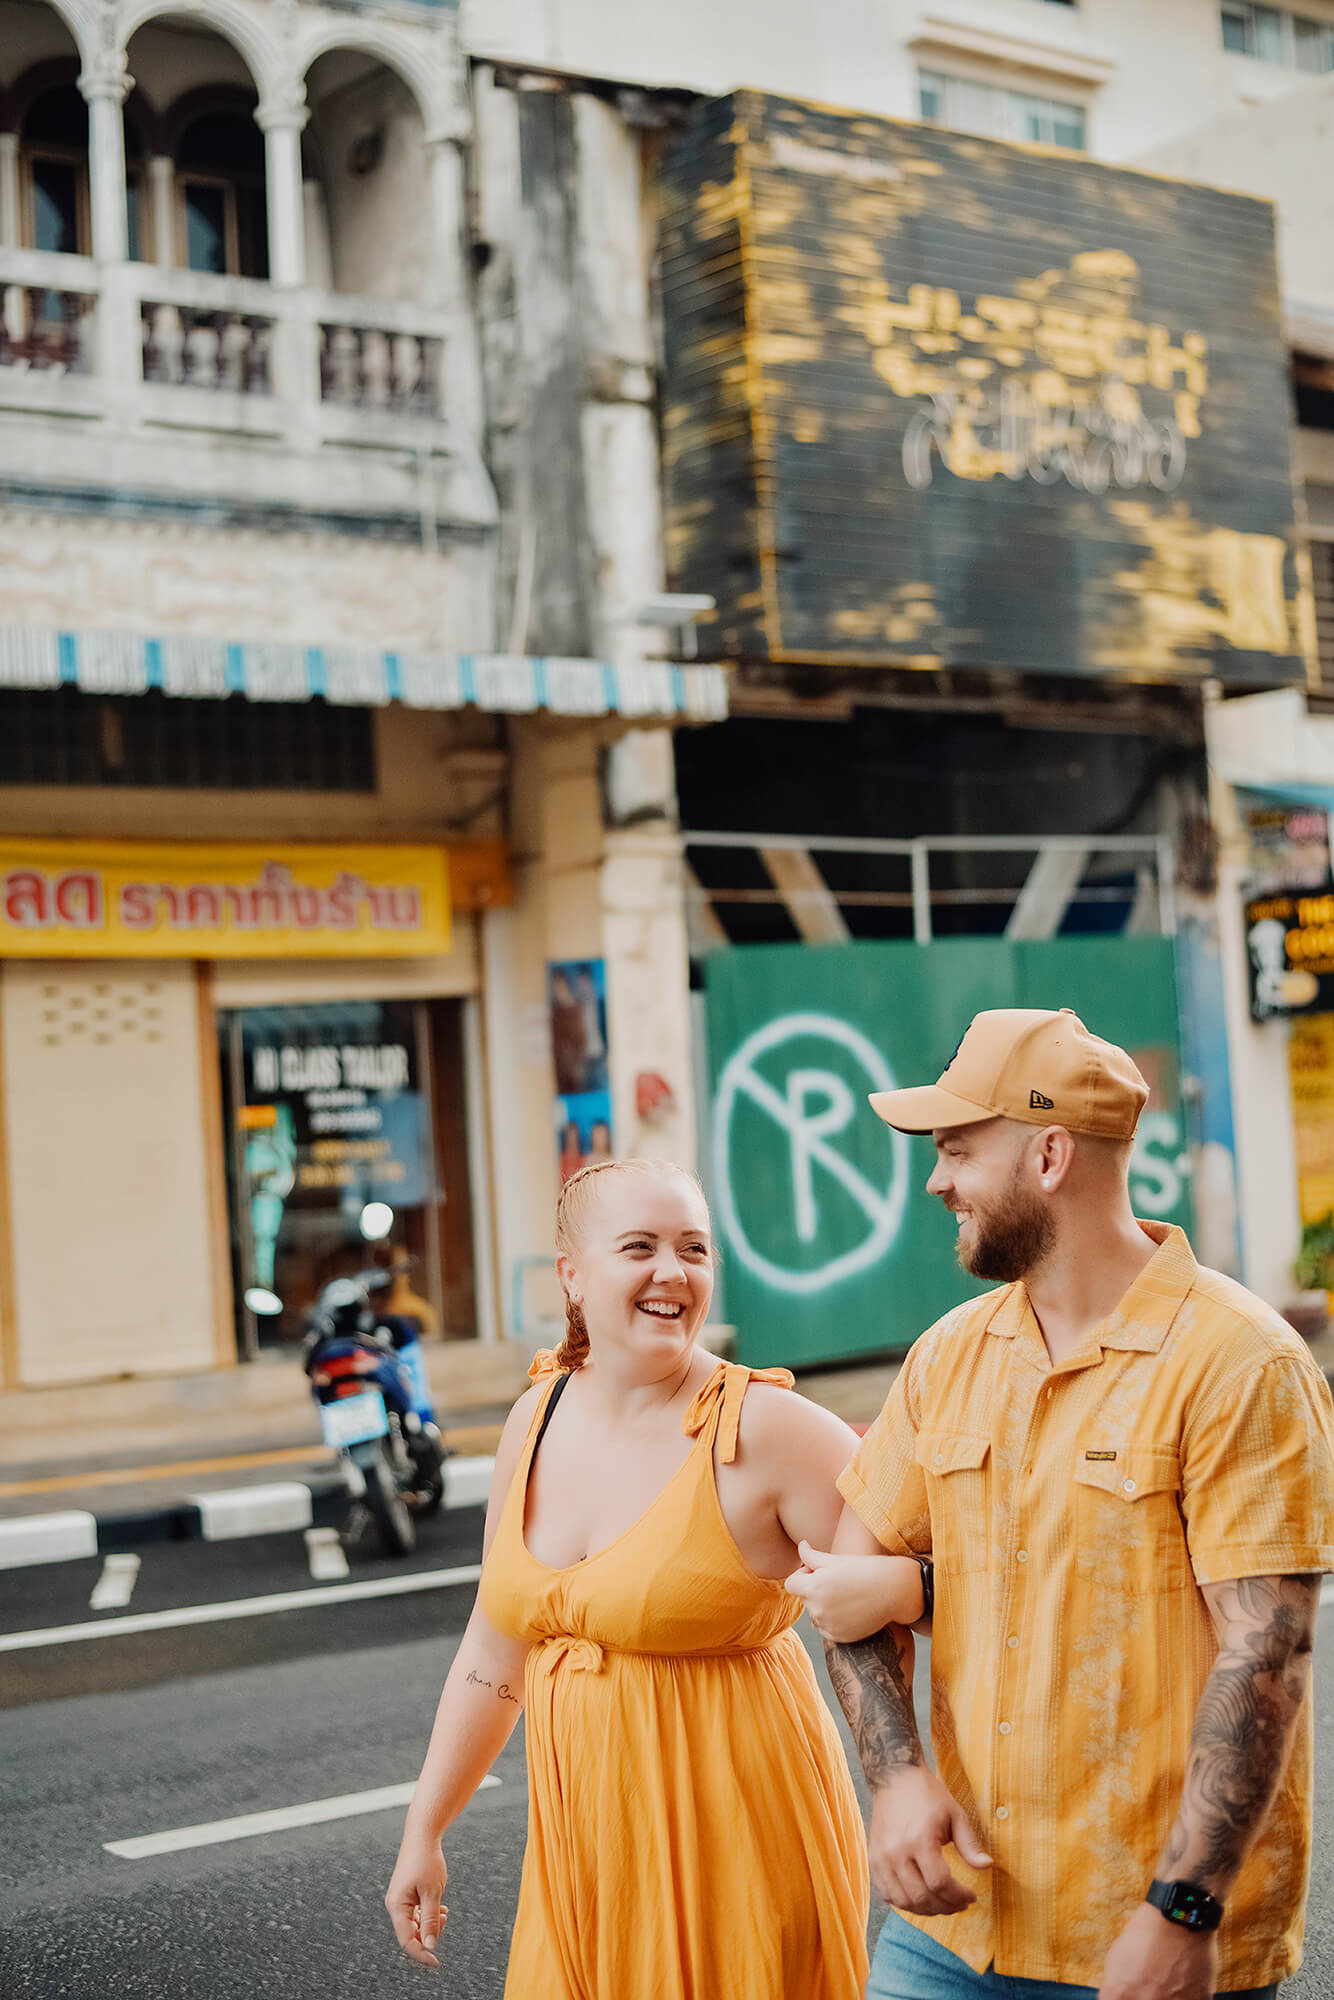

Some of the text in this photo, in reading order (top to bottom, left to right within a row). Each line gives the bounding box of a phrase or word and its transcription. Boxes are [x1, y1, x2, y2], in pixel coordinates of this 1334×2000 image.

[5, 868, 102, 928] ลด
[280, 1046, 341, 1090] CLASS
[342, 1045, 409, 1089] TAILOR
